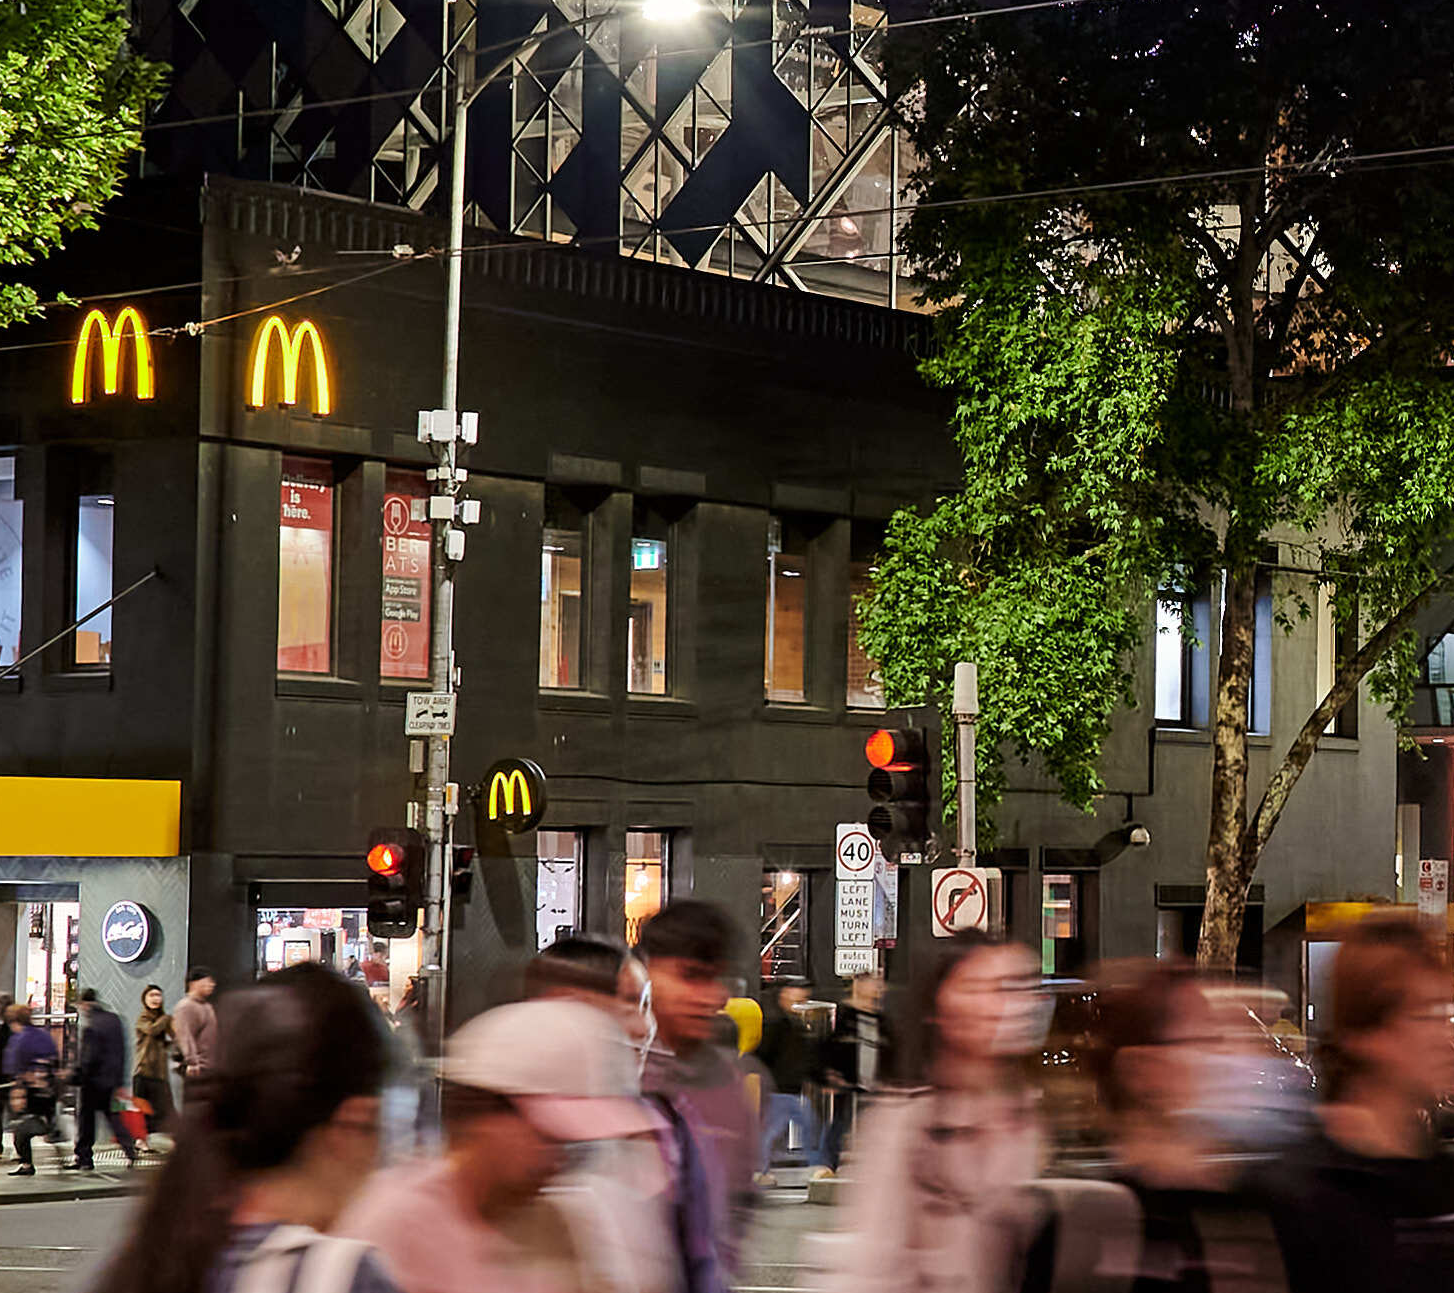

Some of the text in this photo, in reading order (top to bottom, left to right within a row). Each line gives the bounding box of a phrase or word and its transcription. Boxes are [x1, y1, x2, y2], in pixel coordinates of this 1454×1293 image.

[290, 488, 301, 504] is
[385, 535, 419, 555] BER
[385, 555, 419, 573] ATS
[384, 608, 406, 620] Google
[842, 842, 870, 862] 40
[842, 885, 868, 895] LEFT
[841, 897, 869, 907] LANE
[840, 909, 869, 918] MUST
[842, 921, 869, 930] TURN
[842, 933, 867, 942] LEFT
